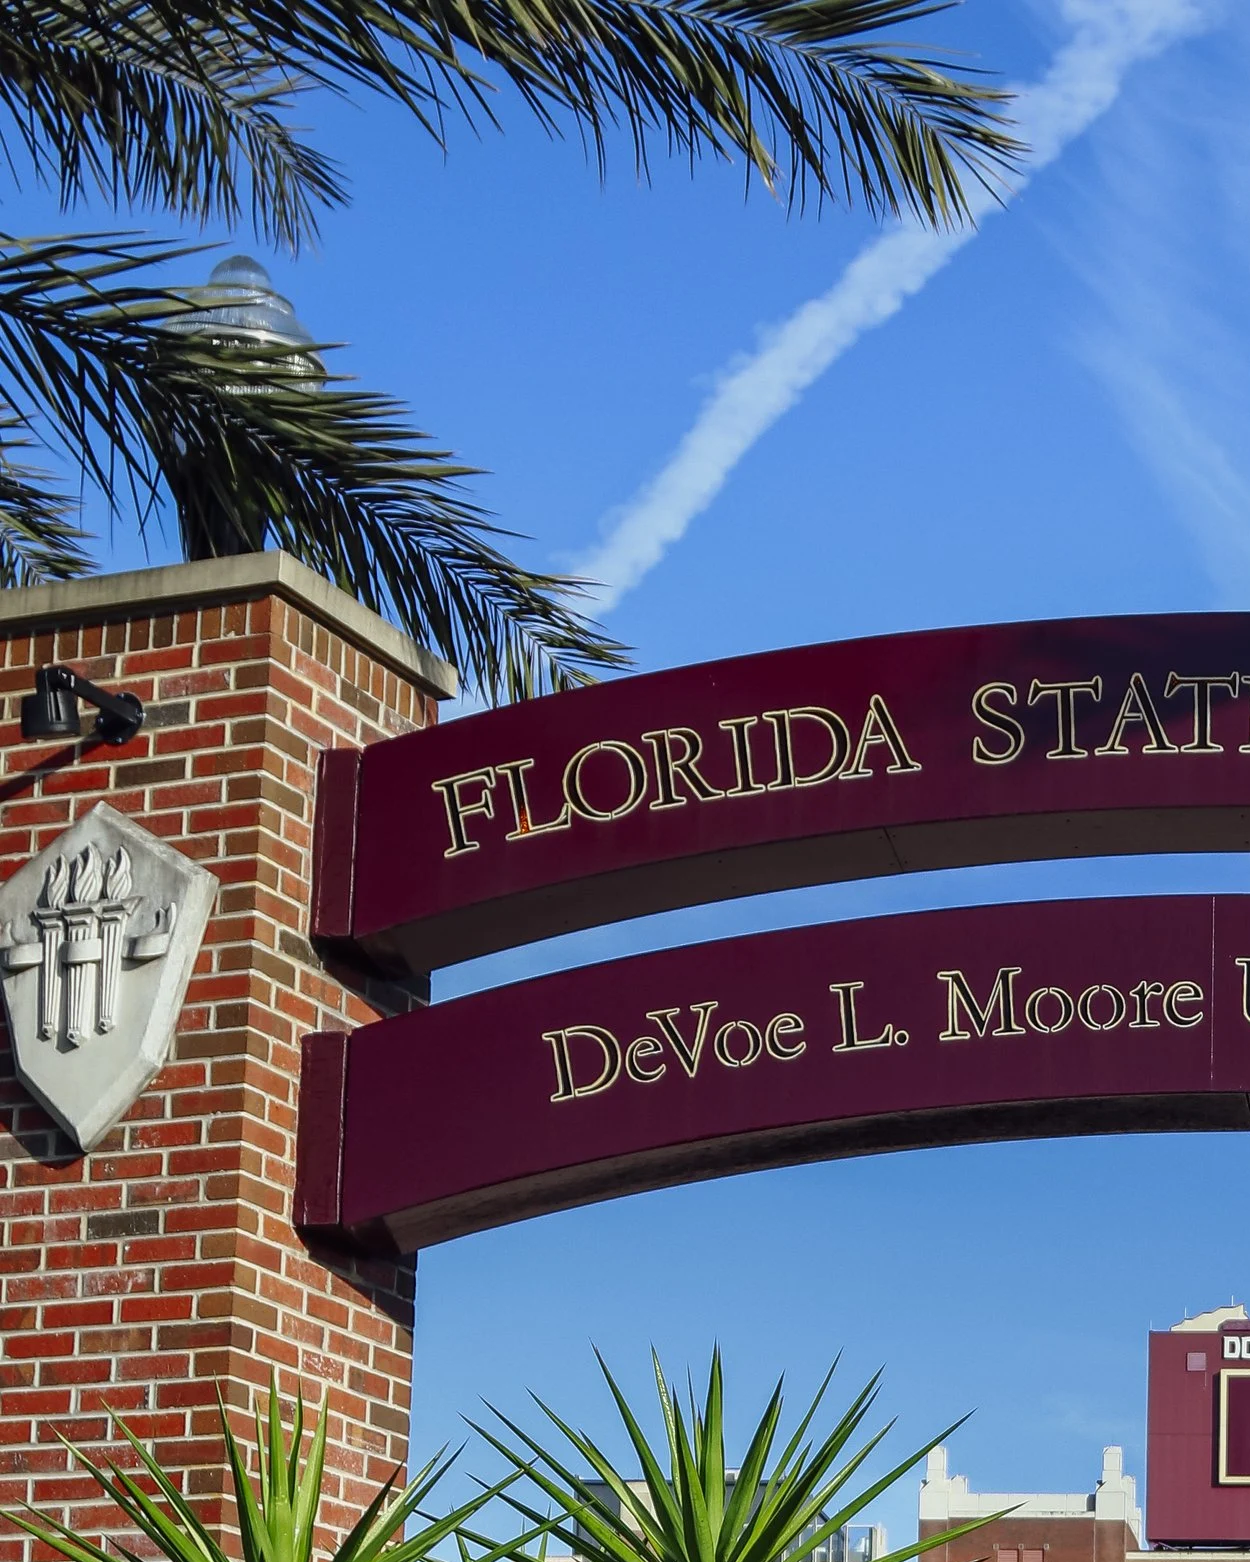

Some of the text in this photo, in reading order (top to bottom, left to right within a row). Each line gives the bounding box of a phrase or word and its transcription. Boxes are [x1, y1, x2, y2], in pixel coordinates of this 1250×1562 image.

[432, 694, 922, 860] FLORIDA
[542, 1001, 806, 1104] DeVoe
[828, 981, 909, 1053] L.
[937, 966, 1205, 1042] Moore
